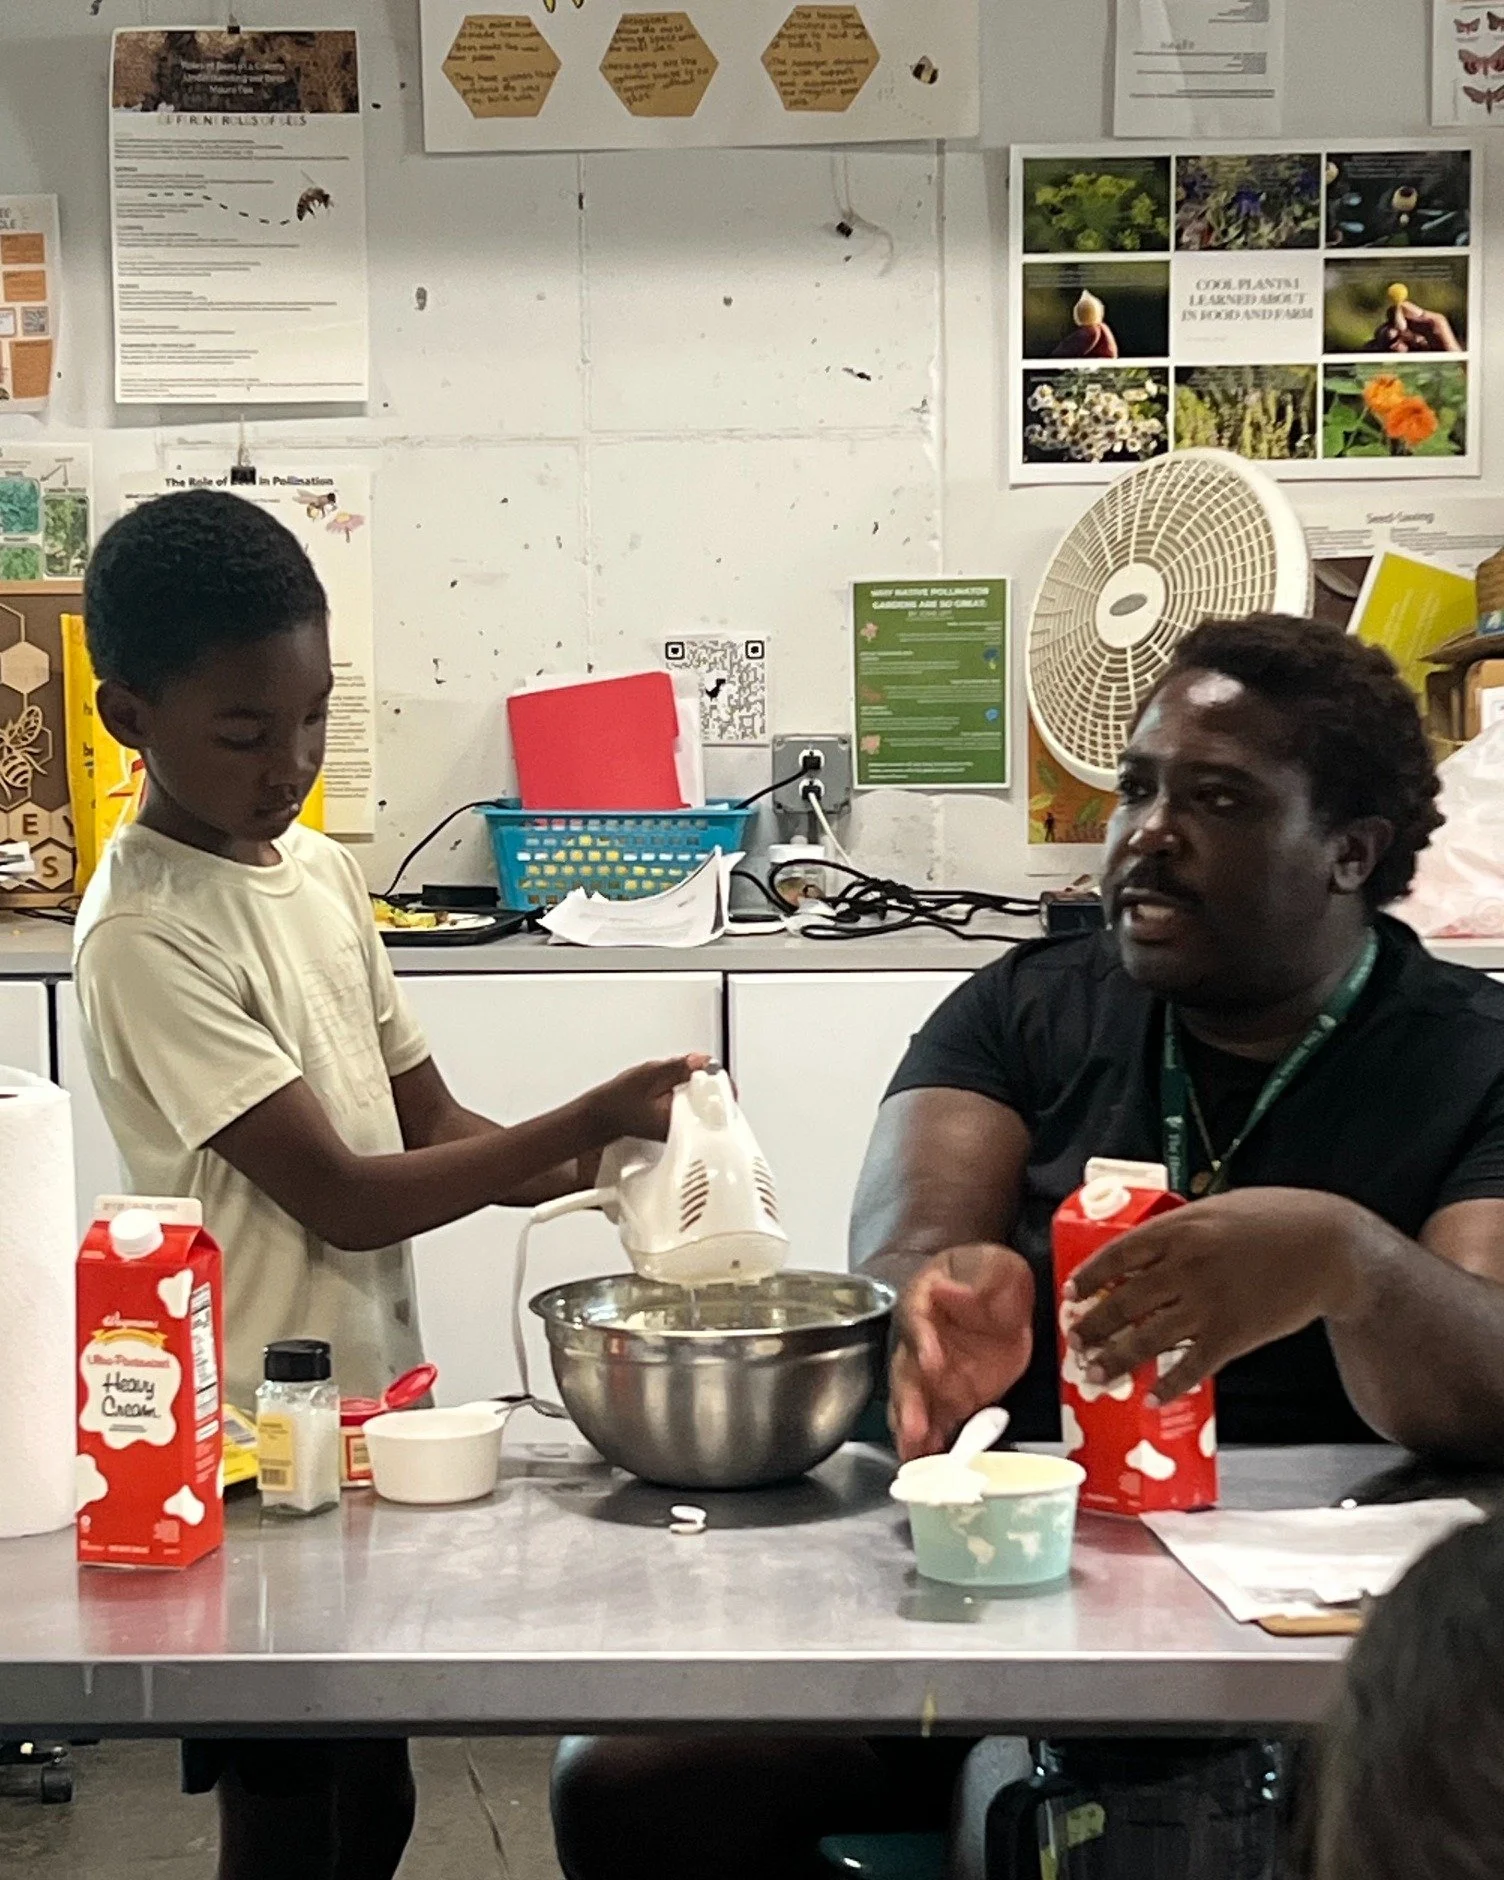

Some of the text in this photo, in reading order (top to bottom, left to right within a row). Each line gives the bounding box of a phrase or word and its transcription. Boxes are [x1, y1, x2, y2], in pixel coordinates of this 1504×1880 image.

[1195, 278, 1232, 290] COOL
[1188, 292, 1308, 306] LEARNED ABOUT
[1181, 307, 1314, 321] IN FOOD AND FARM
[165, 477, 185, 487] The
[188, 477, 213, 487] Role
[216, 476, 227, 487] of
[272, 475, 333, 486] Pollination
[42, 856, 59, 878] S
[102, 1371, 156, 1401] Heavy
[101, 1395, 162, 1419] Cream
